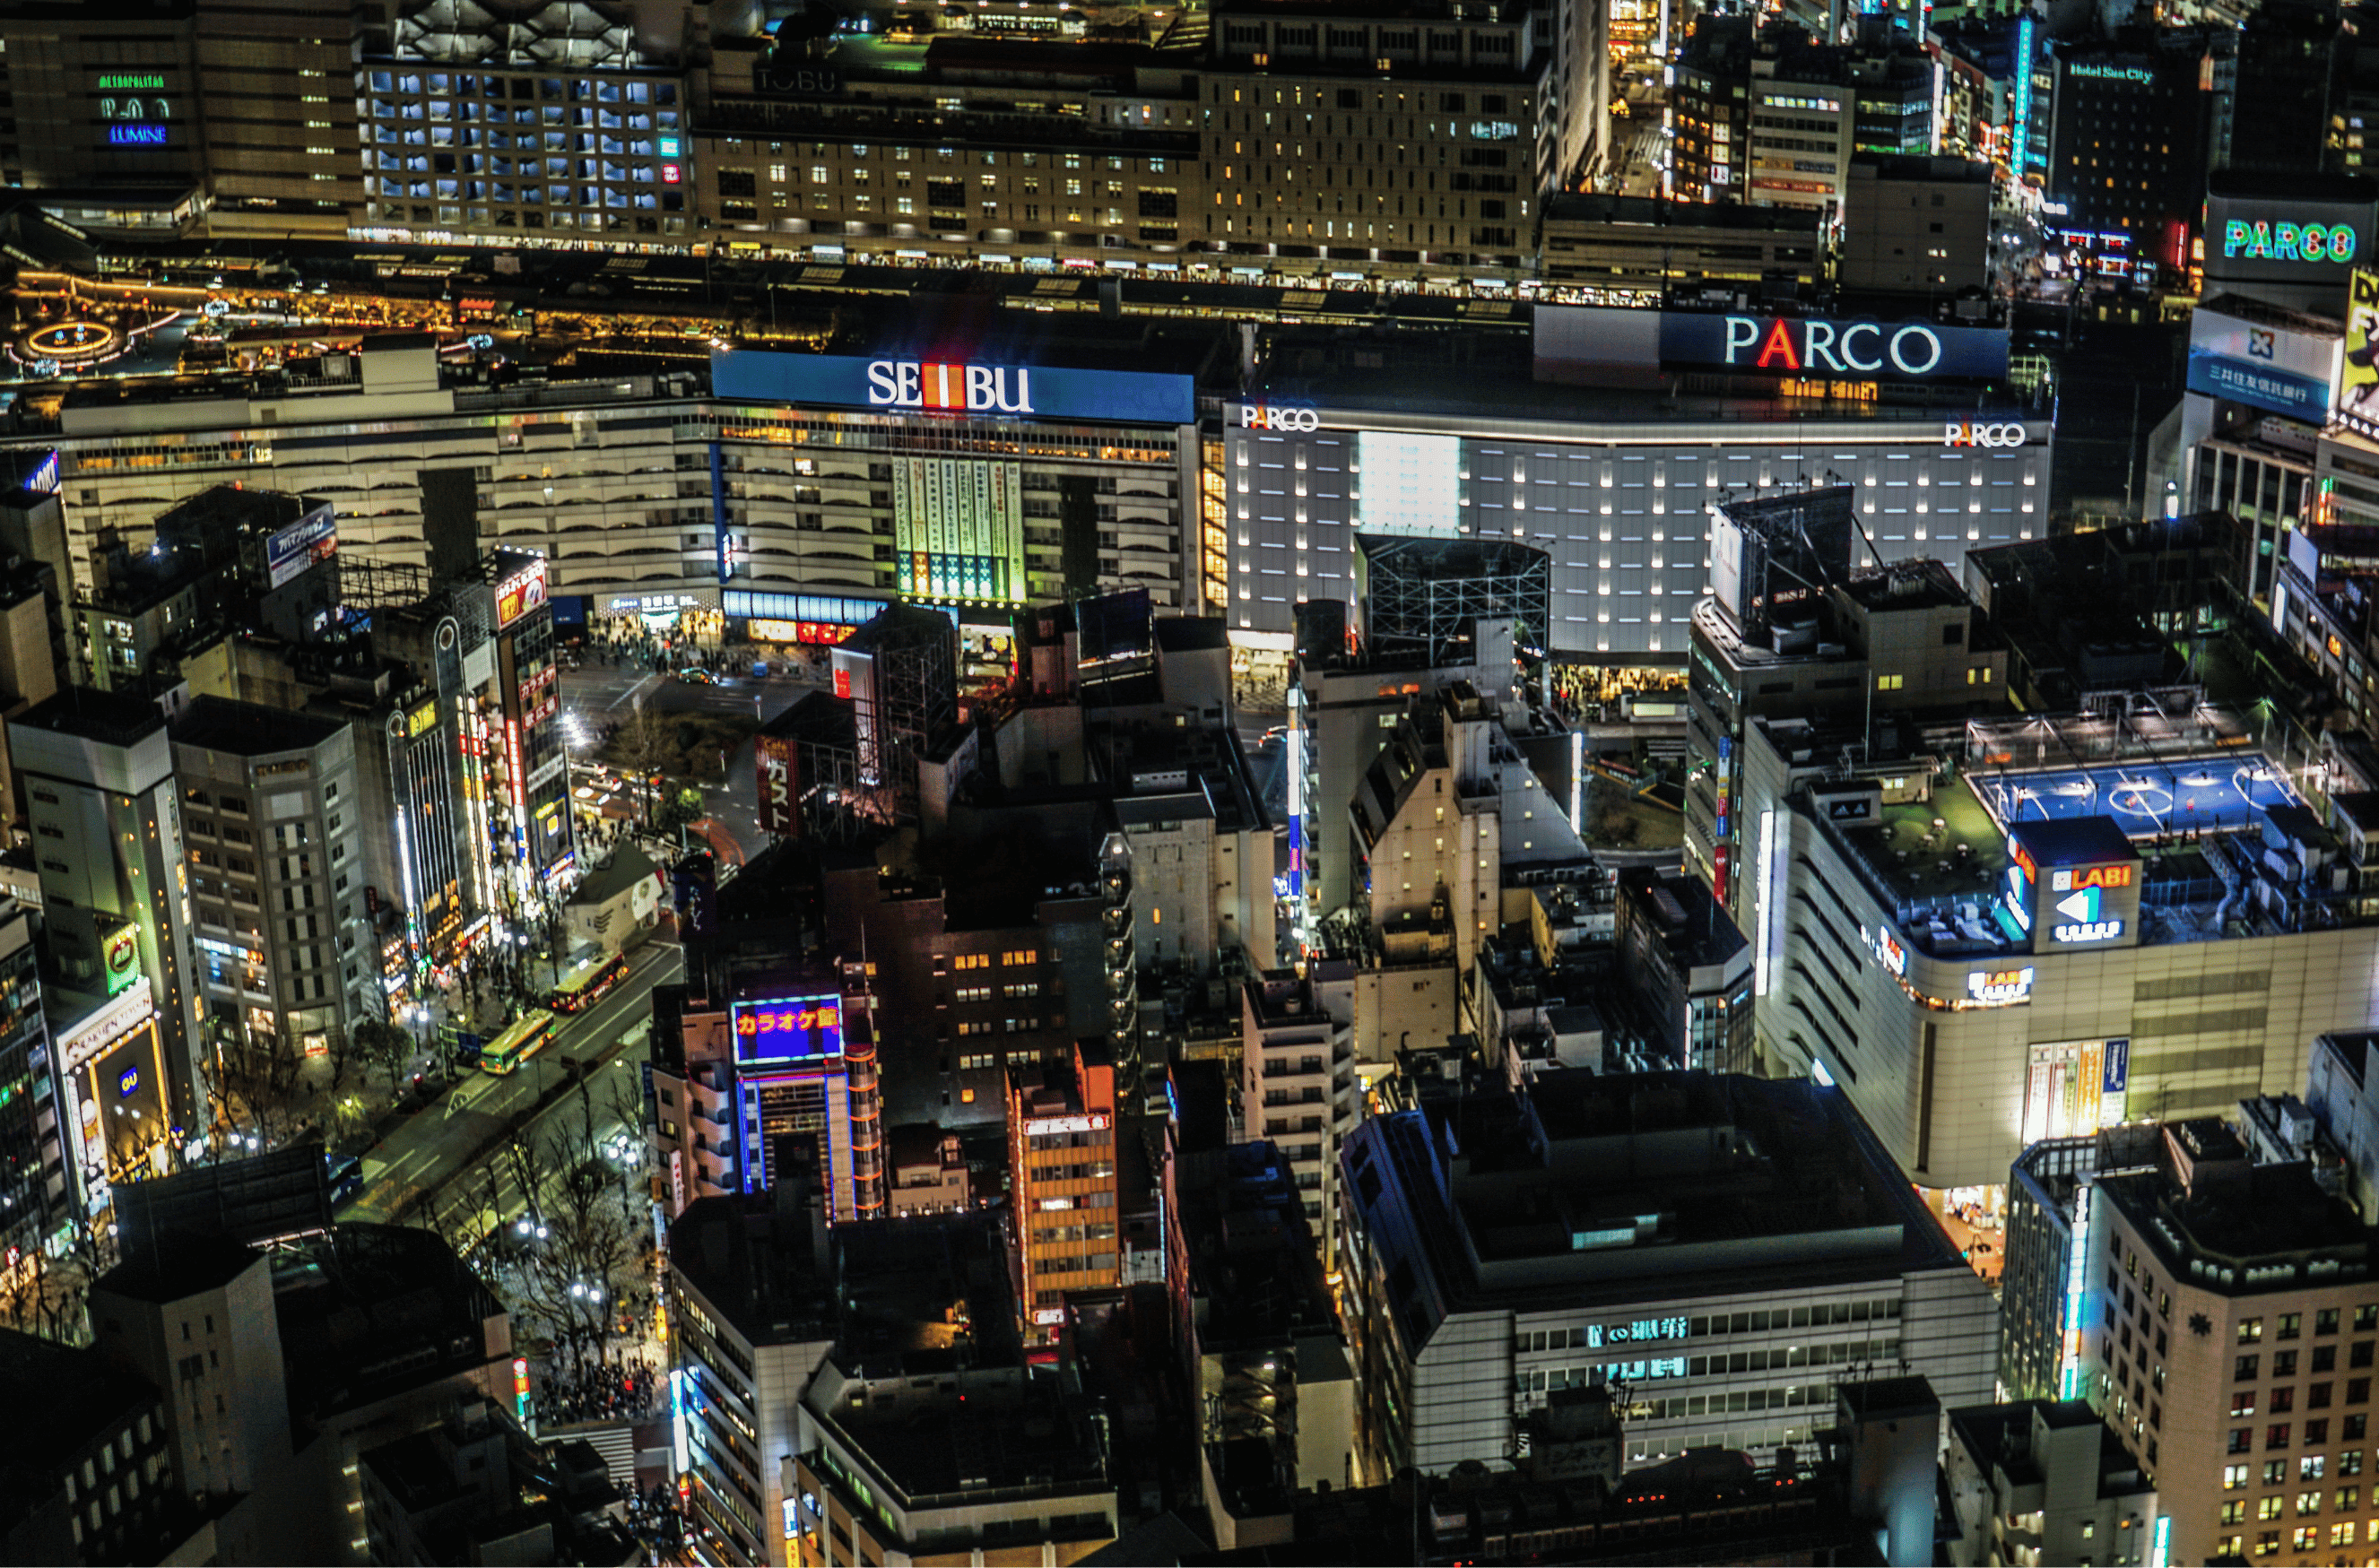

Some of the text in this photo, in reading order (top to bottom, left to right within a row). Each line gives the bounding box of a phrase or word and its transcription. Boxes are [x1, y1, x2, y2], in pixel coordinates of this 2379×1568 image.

[110, 125, 166, 143] LUMINE
[2225, 219, 2357, 264] PARCO
[1725, 316, 1941, 374] PARCO
[867, 360, 1035, 413] SEIBU
[1242, 406, 1319, 432] PARCO
[1945, 422, 2026, 447] PARCO
[768, 759, 790, 828] ガスト
[2071, 865, 2132, 890] LABI
[737, 1008, 838, 1035] カラオケ館
[122, 1071, 138, 1091] GU
